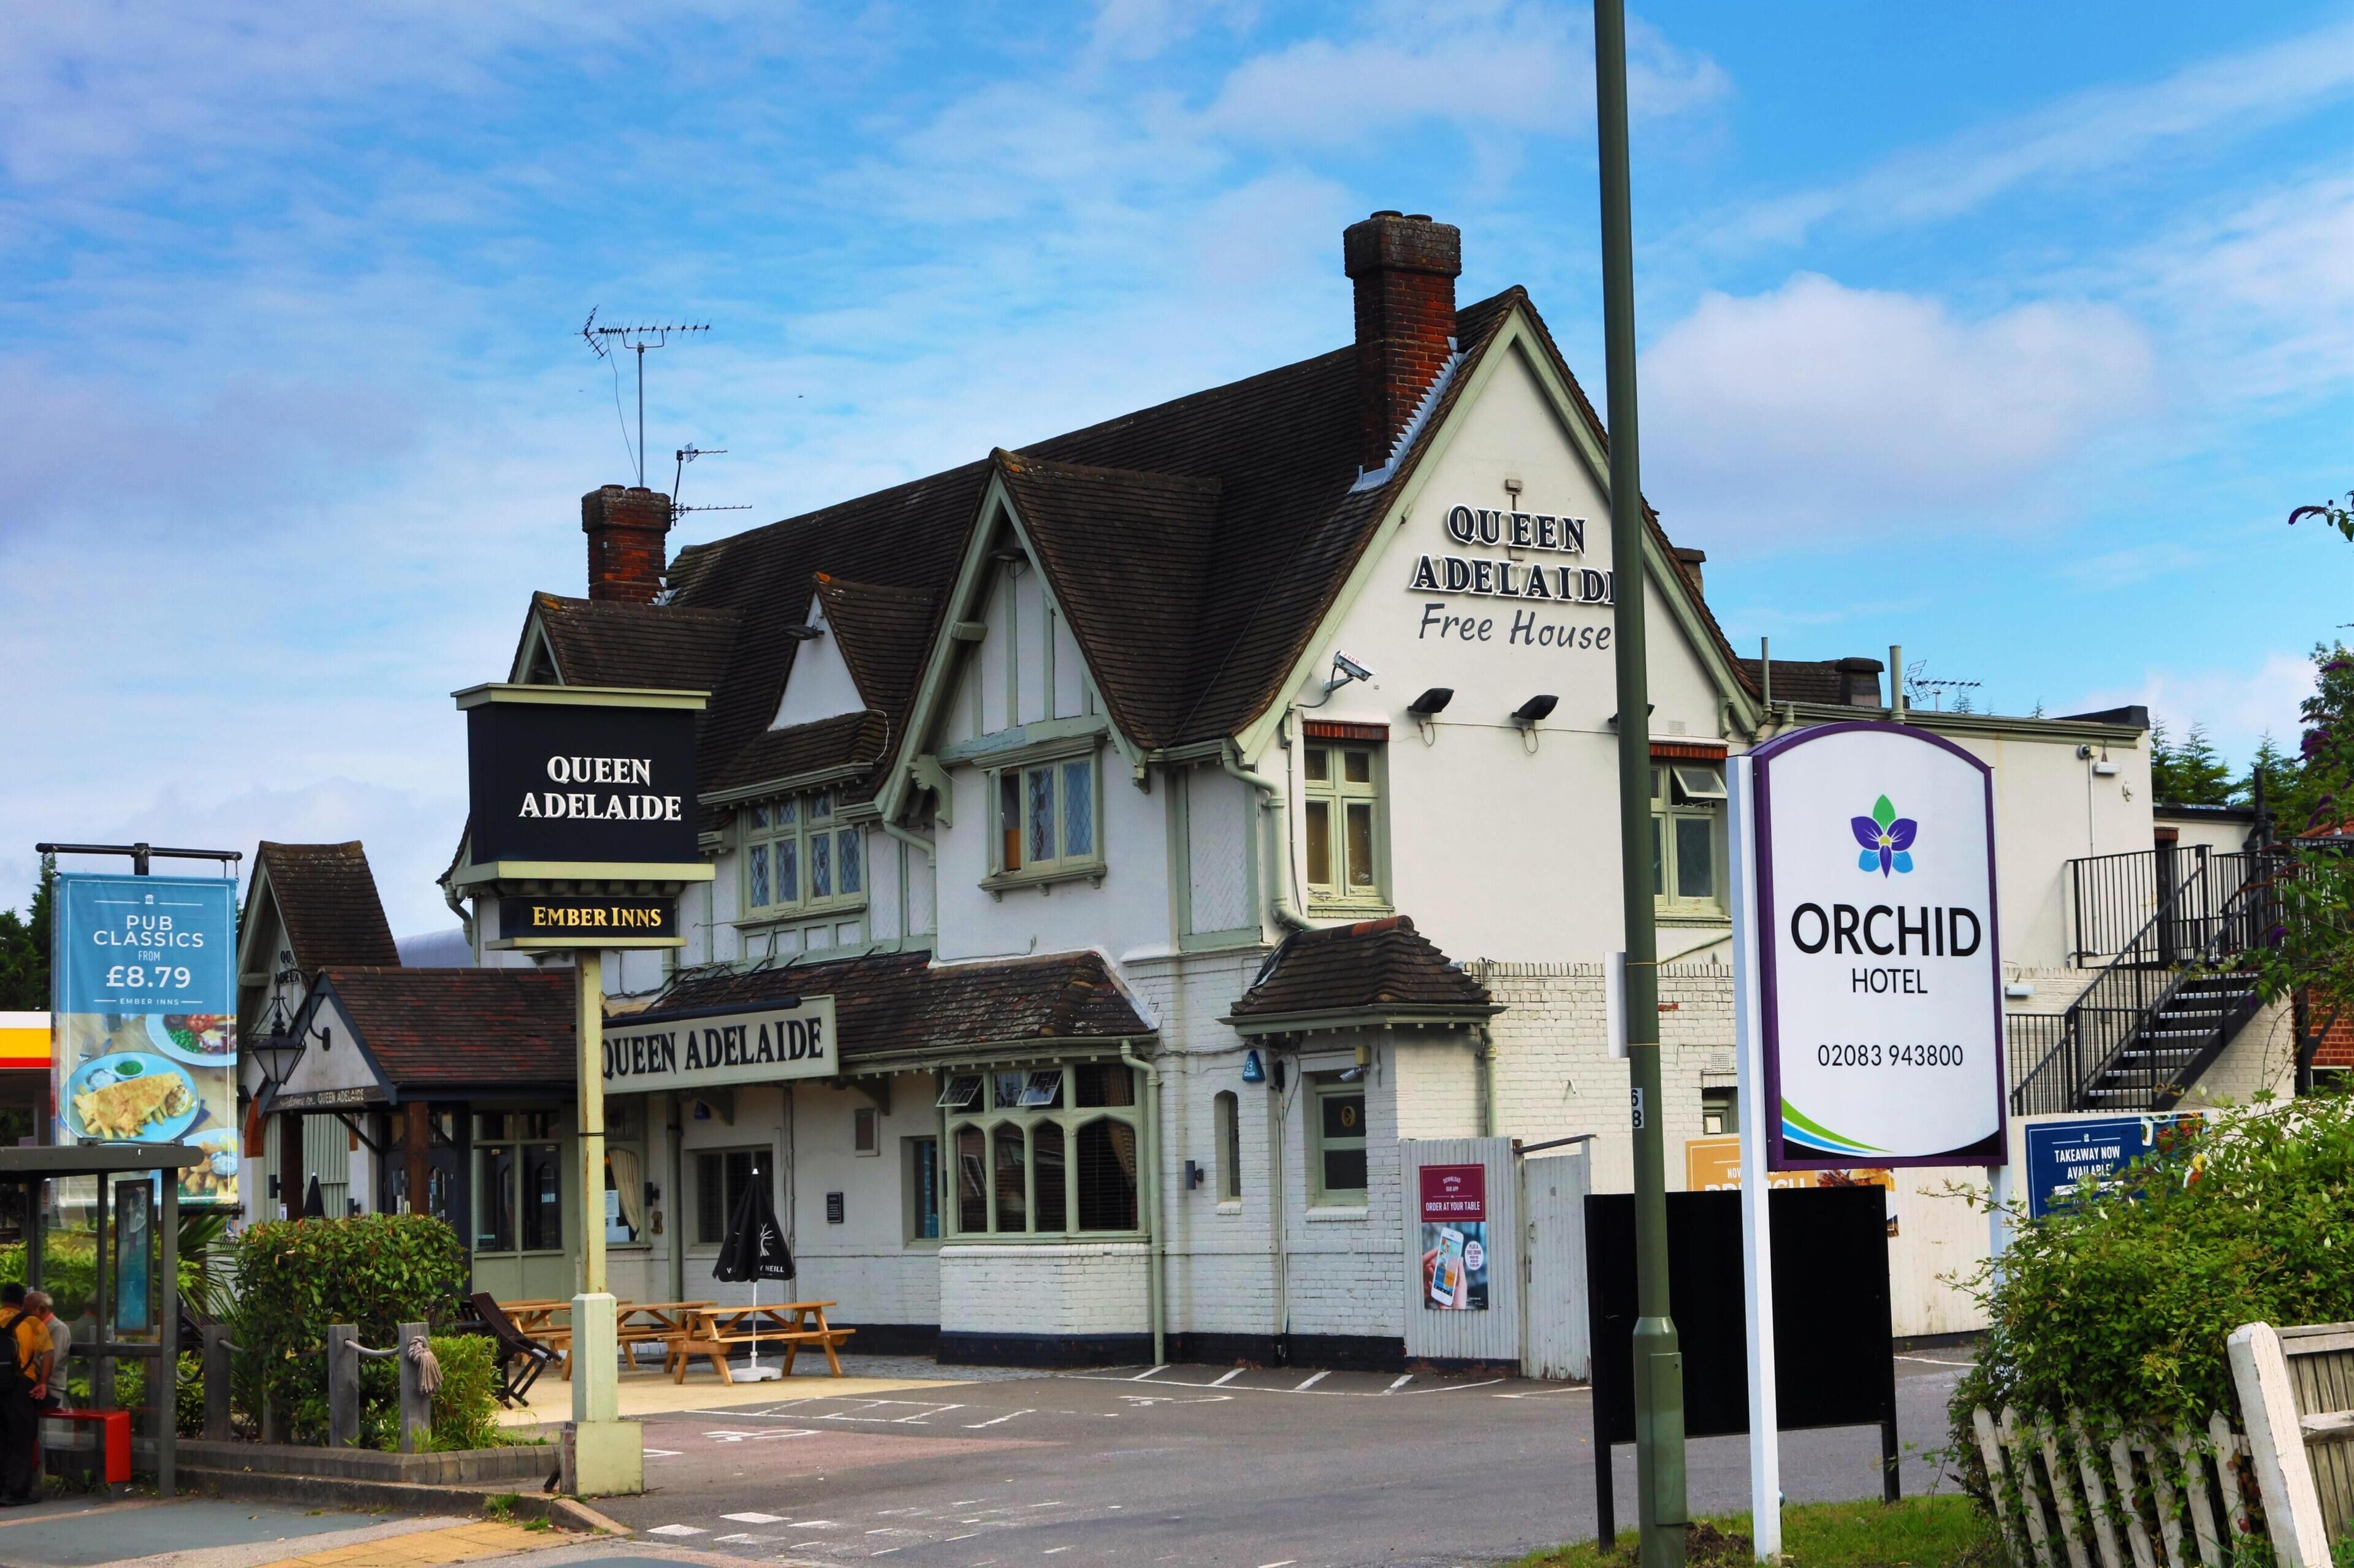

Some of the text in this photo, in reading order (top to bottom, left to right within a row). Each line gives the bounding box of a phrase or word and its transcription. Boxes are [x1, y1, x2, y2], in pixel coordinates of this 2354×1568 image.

[1447, 503, 1589, 559] QUEEN
[1419, 603, 1612, 650] Free House
[547, 756, 652, 787] QUEEN
[518, 792, 682, 821] ADELAIDE
[126, 915, 173, 931] PUB
[532, 906, 662, 928] EMBER INNS
[93, 930, 204, 948] CLASSICS
[1791, 902, 1981, 957] ORCHID
[138, 951, 161, 961] FROM
[106, 965, 191, 988] £8.79
[1852, 968, 1928, 994] HOTEL
[603, 1017, 823, 1080] QUEEN ADELAIDE
[1818, 1045, 1963, 1066] 02083 943800
[318, 1092, 335, 1104] QUEEN
[337, 1088, 364, 1103] ADELAIDE
[2054, 1146, 2120, 1163] TAKEAWAY NOW
[1426, 1201, 1480, 1211] ORDER AT YOUR TABLE
